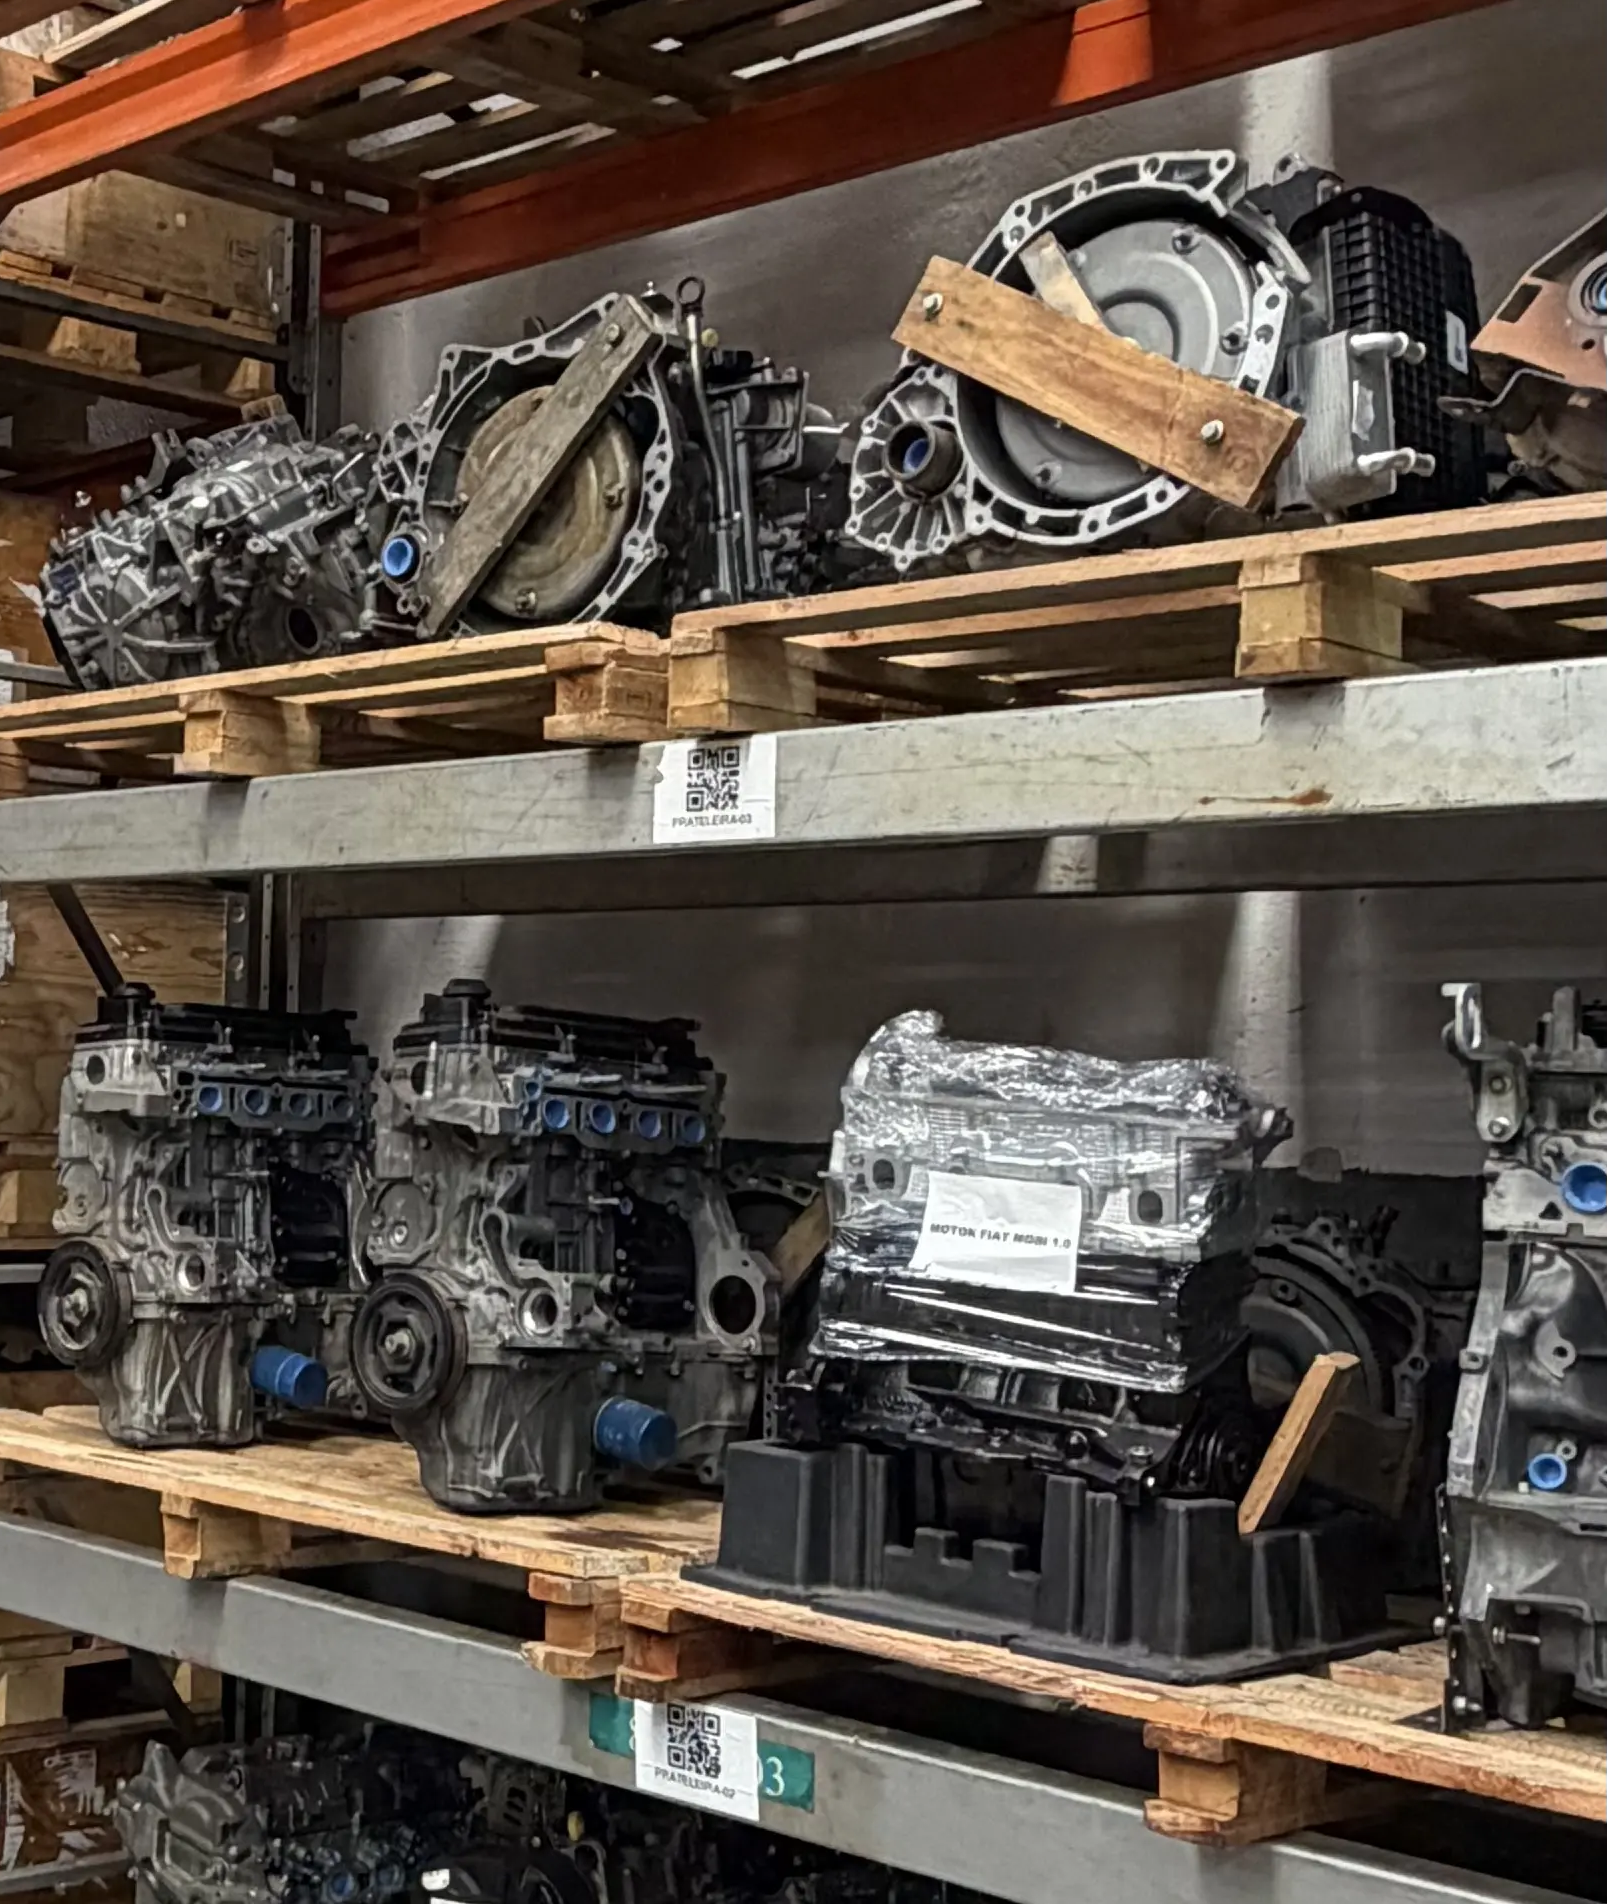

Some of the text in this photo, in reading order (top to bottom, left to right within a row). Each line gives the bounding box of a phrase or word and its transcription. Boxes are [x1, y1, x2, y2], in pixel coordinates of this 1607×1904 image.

[930, 1223, 1072, 1250] MOTOR FIAT MOBI 1.0
